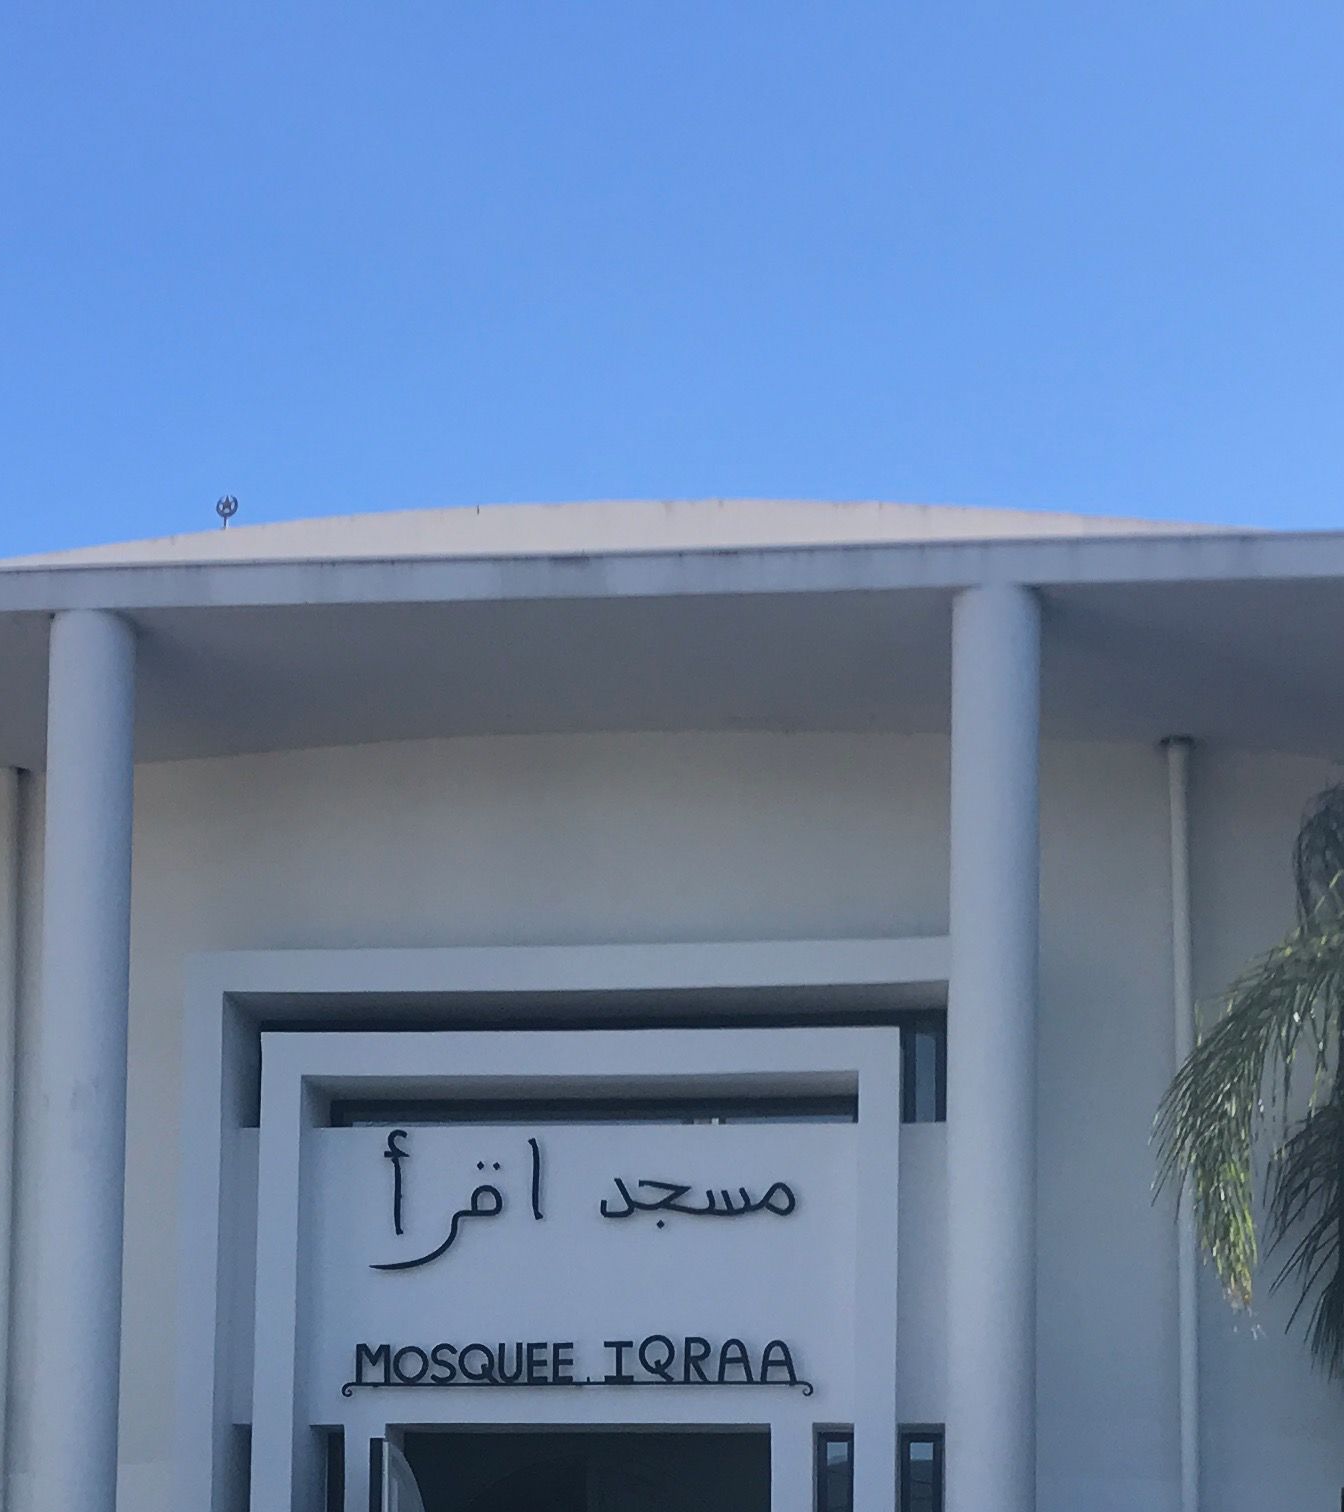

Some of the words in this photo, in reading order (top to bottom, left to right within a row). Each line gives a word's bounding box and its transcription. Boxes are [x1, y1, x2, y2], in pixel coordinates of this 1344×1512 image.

[600, 1177, 797, 1230] مسجد
[356, 1342, 574, 1385] MOSQUEE
[603, 1334, 798, 1384] IQRAA
